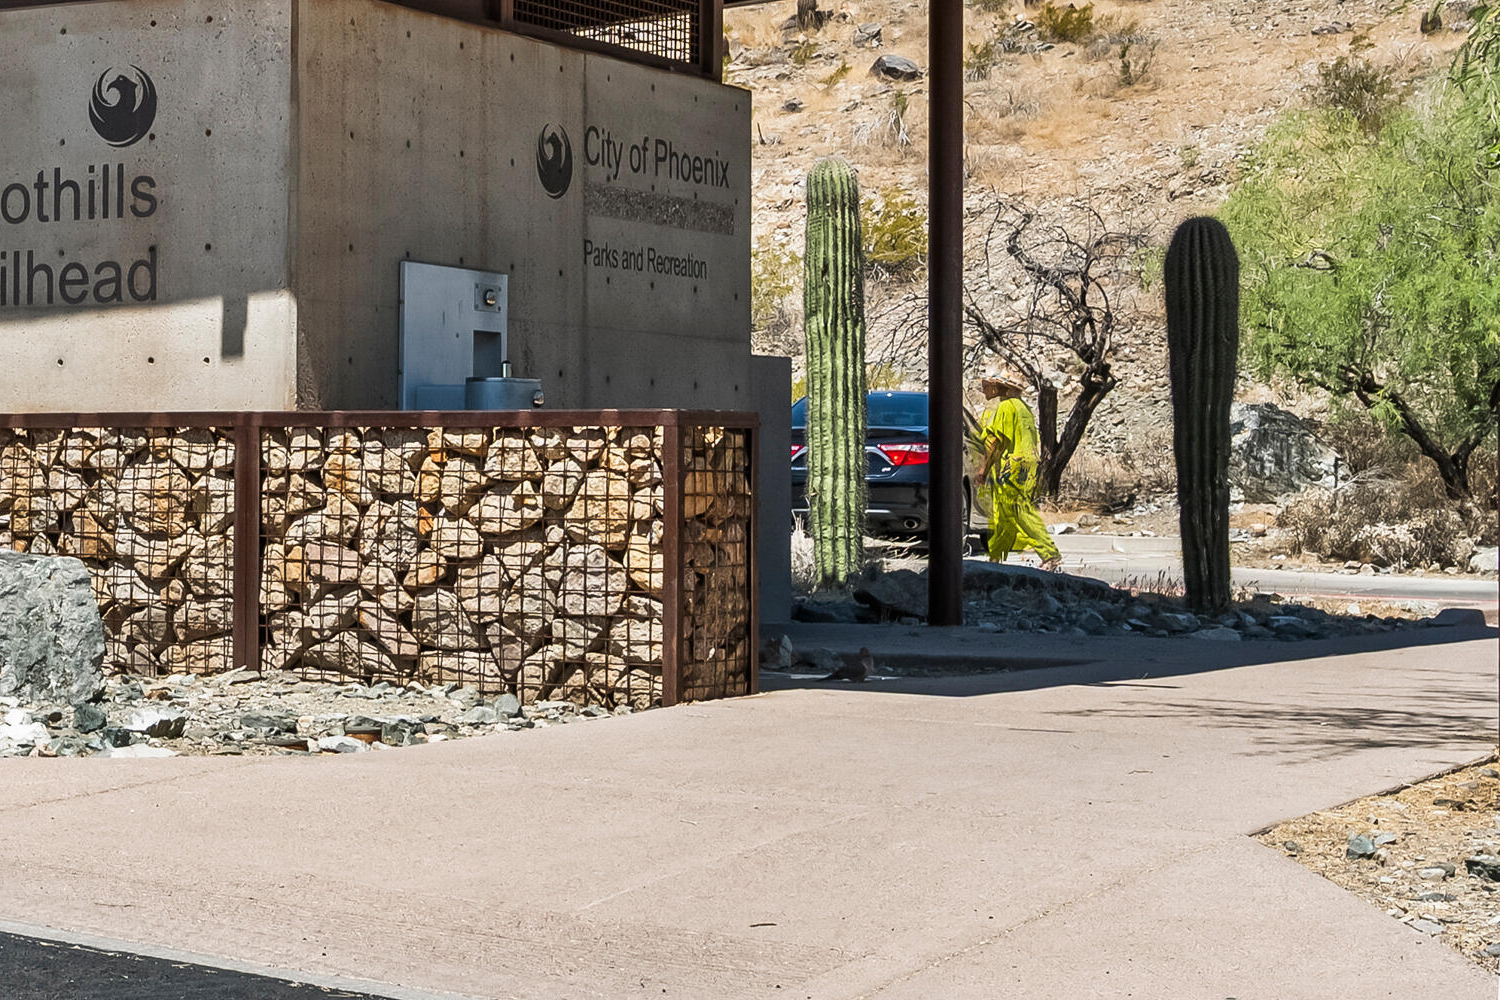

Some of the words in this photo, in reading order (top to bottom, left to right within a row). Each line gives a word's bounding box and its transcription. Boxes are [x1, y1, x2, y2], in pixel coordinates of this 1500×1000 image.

[584, 125, 623, 180] City
[629, 137, 649, 174] of
[654, 139, 730, 189] Phoenix
[583, 238, 619, 269] Parks
[622, 246, 644, 272] and
[647, 247, 707, 280] Recreation
